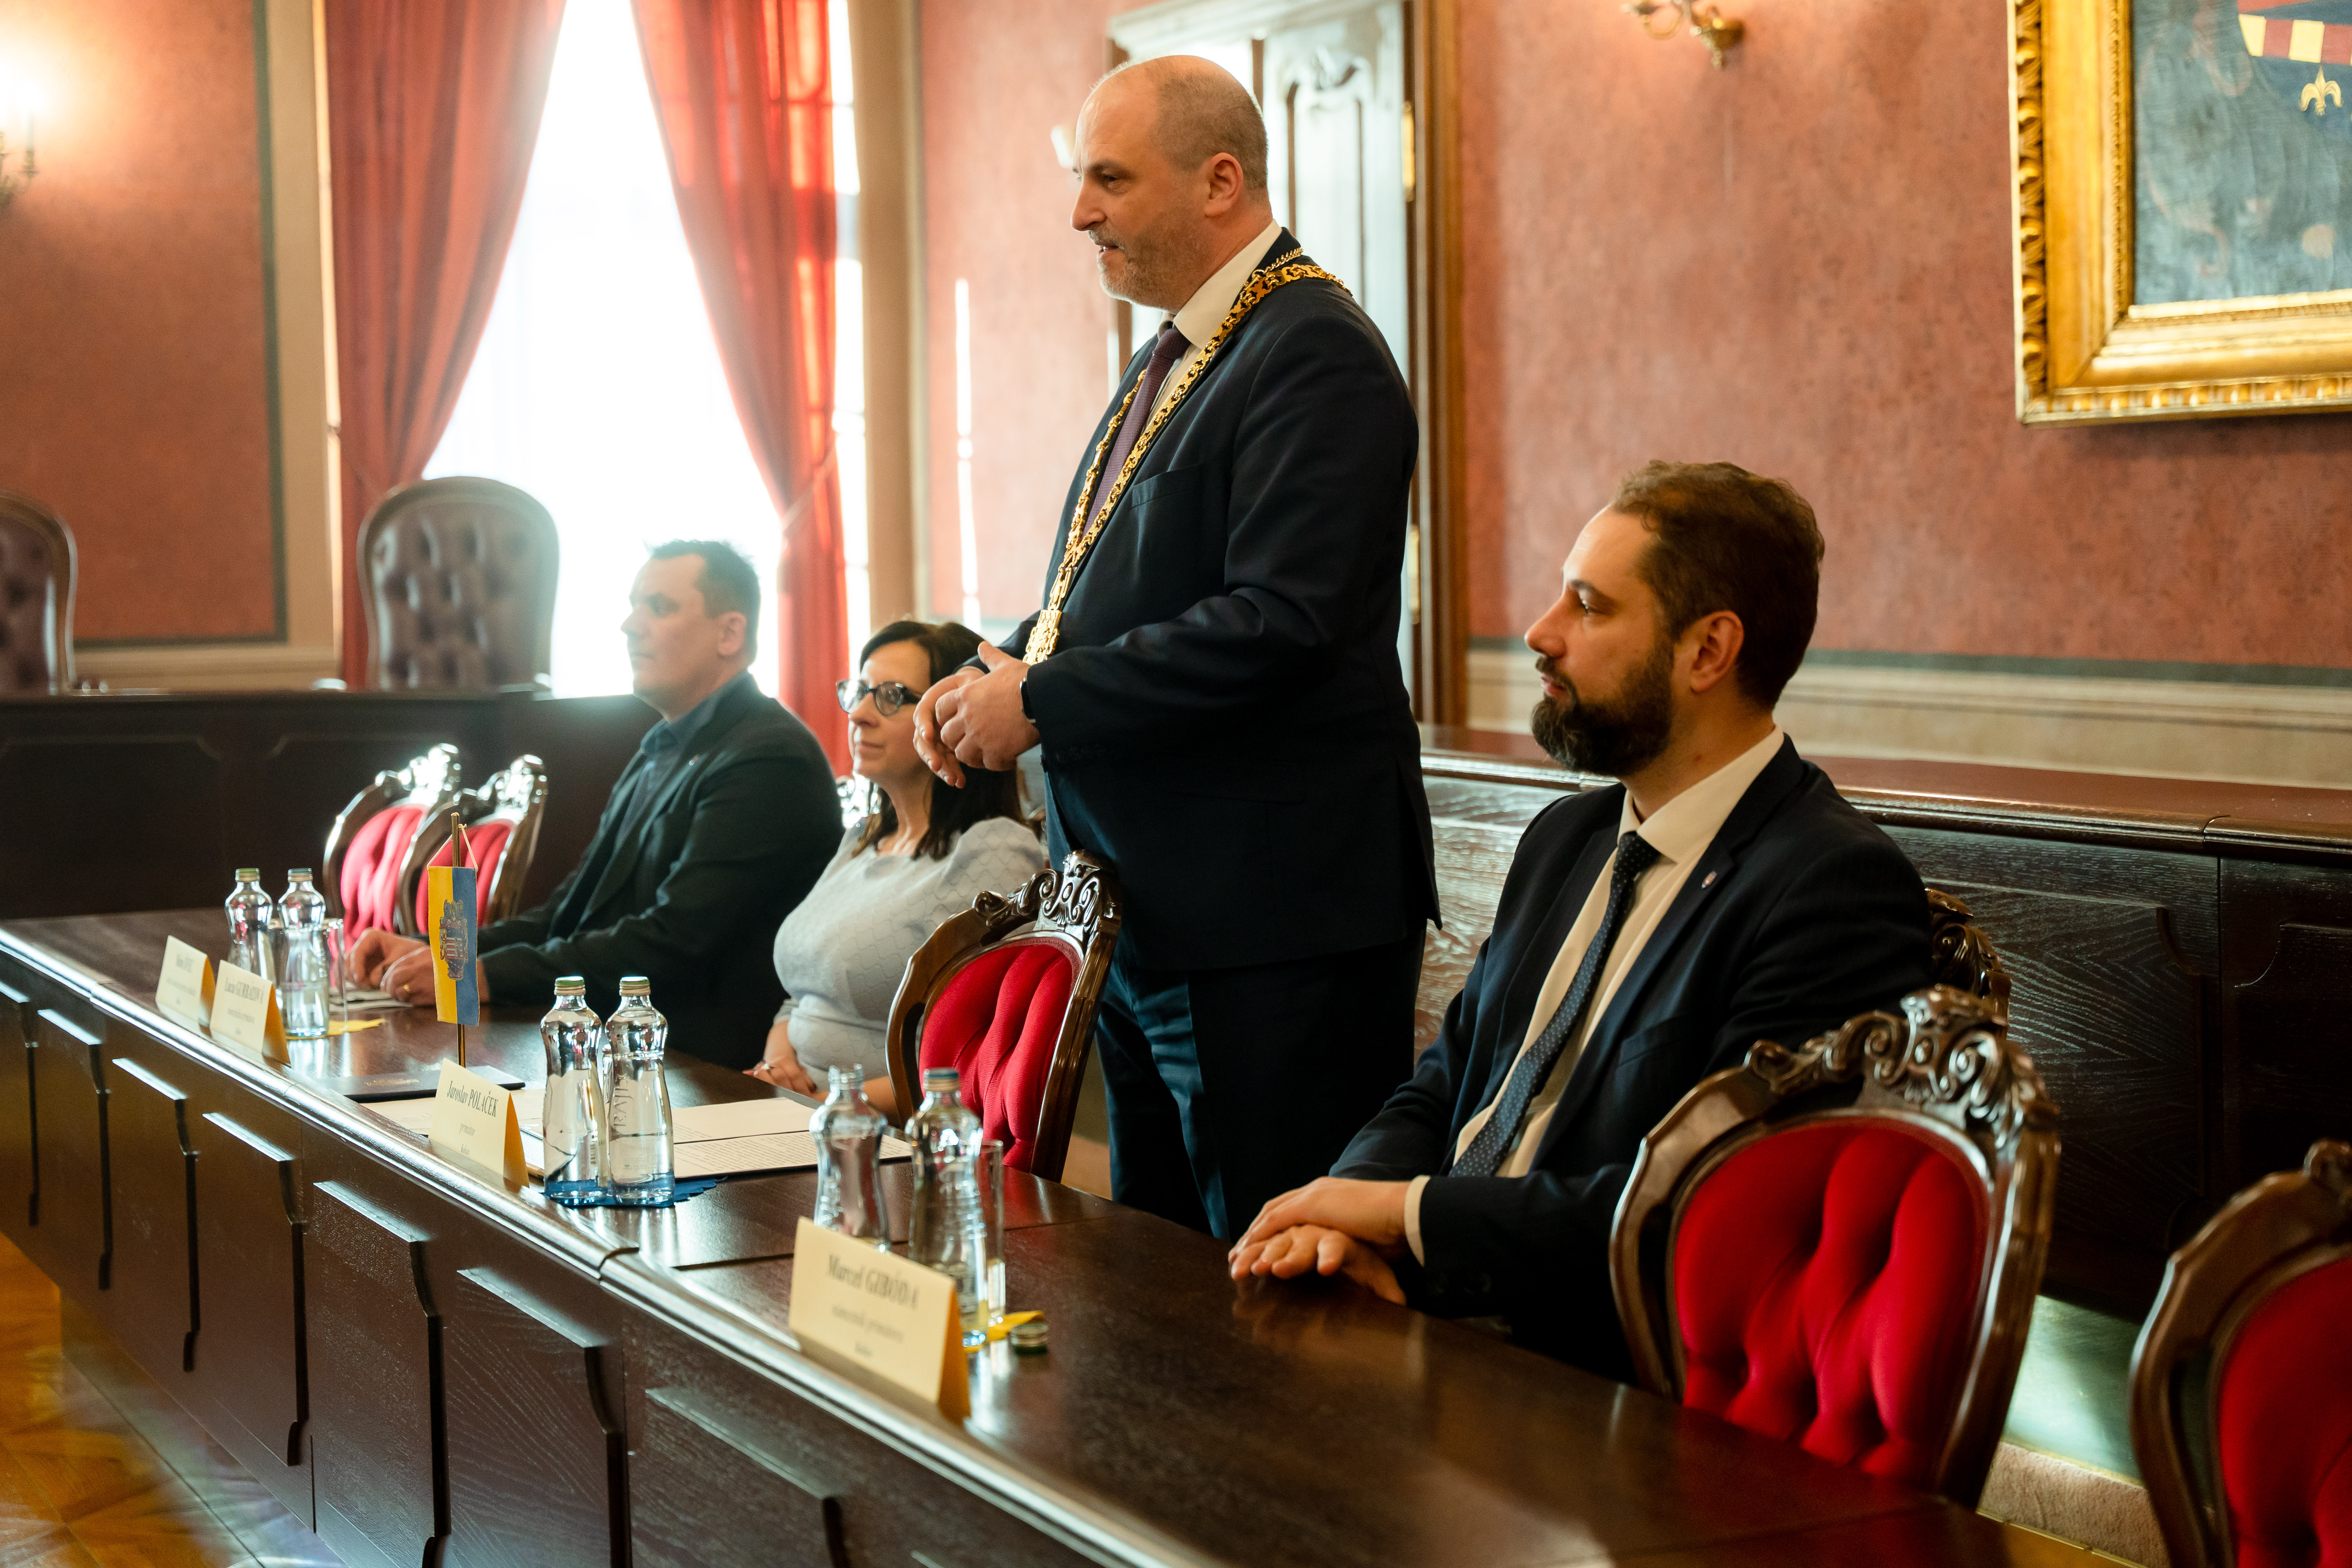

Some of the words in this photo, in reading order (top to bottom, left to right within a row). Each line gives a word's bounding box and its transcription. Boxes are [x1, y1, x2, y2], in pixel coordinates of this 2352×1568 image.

[447, 1080, 468, 1104] Jaroslav
[468, 1089, 499, 1117] POLAČEK
[828, 1254, 864, 1289] Marcel
